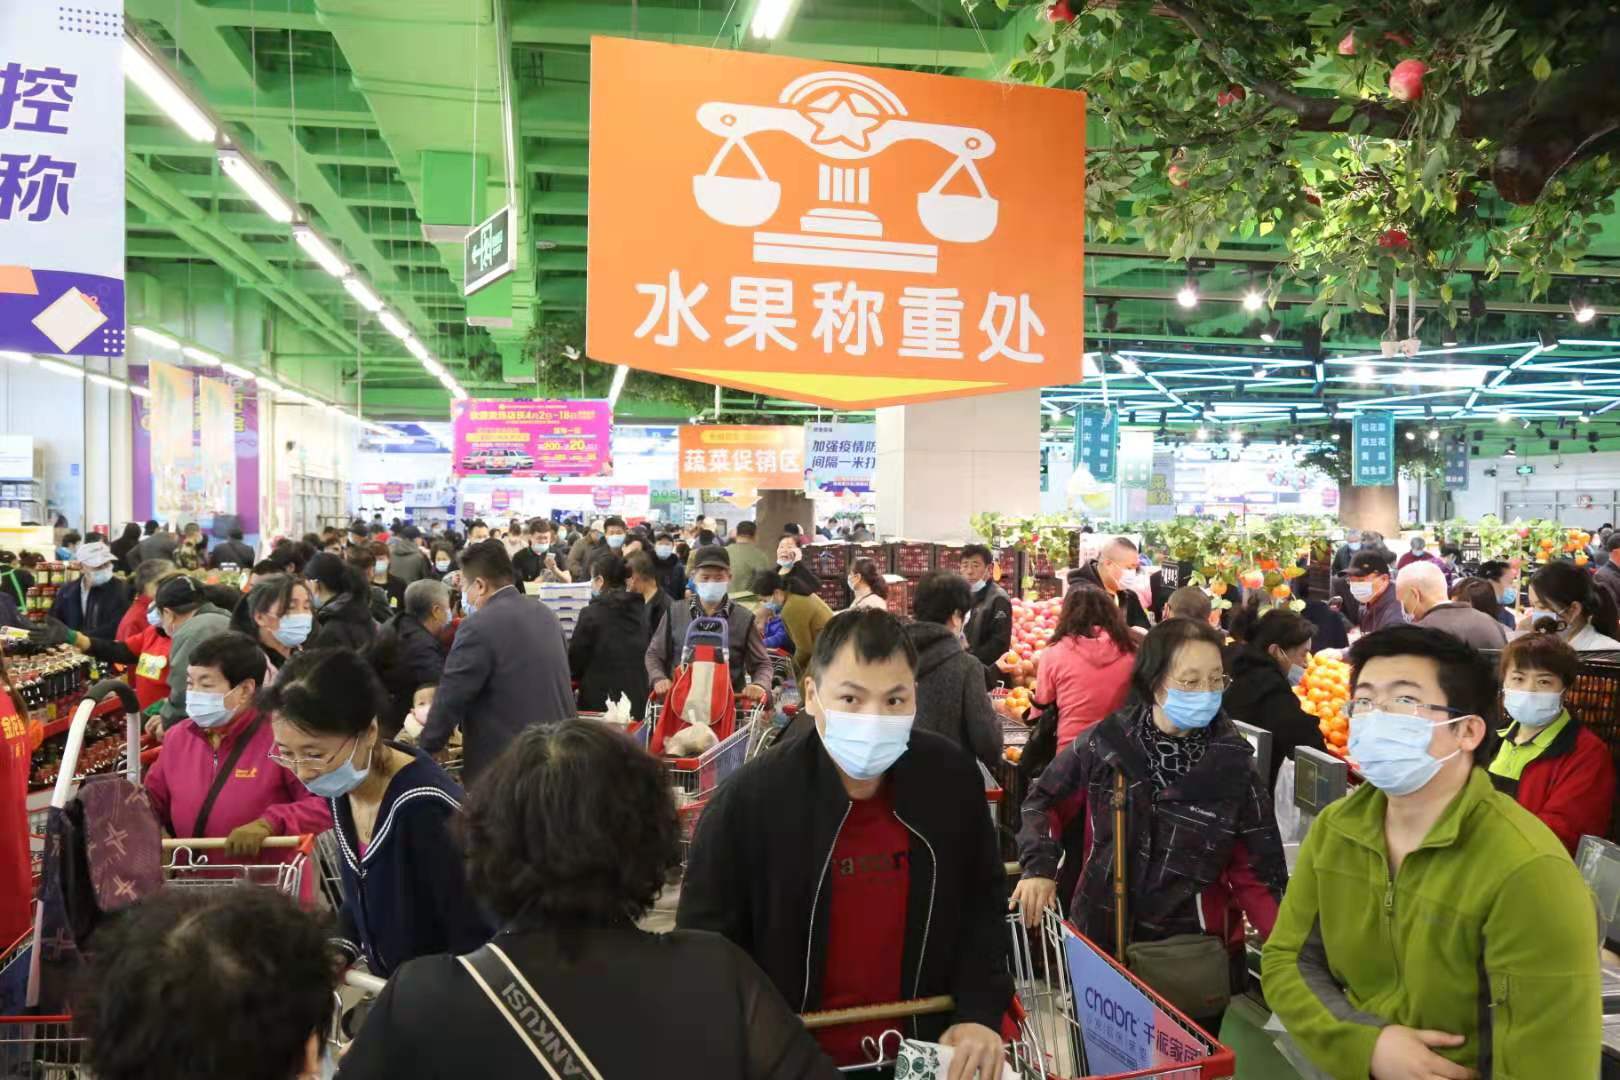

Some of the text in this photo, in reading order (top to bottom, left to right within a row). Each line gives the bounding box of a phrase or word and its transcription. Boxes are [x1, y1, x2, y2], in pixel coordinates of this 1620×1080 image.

[0, 62, 78, 135] 控
[0, 153, 77, 221] 称
[634, 270, 1046, 364] 水果称重处
[684, 448, 801, 473] 蔬菜促销区
[812, 439, 876, 453] 加强疫情防
